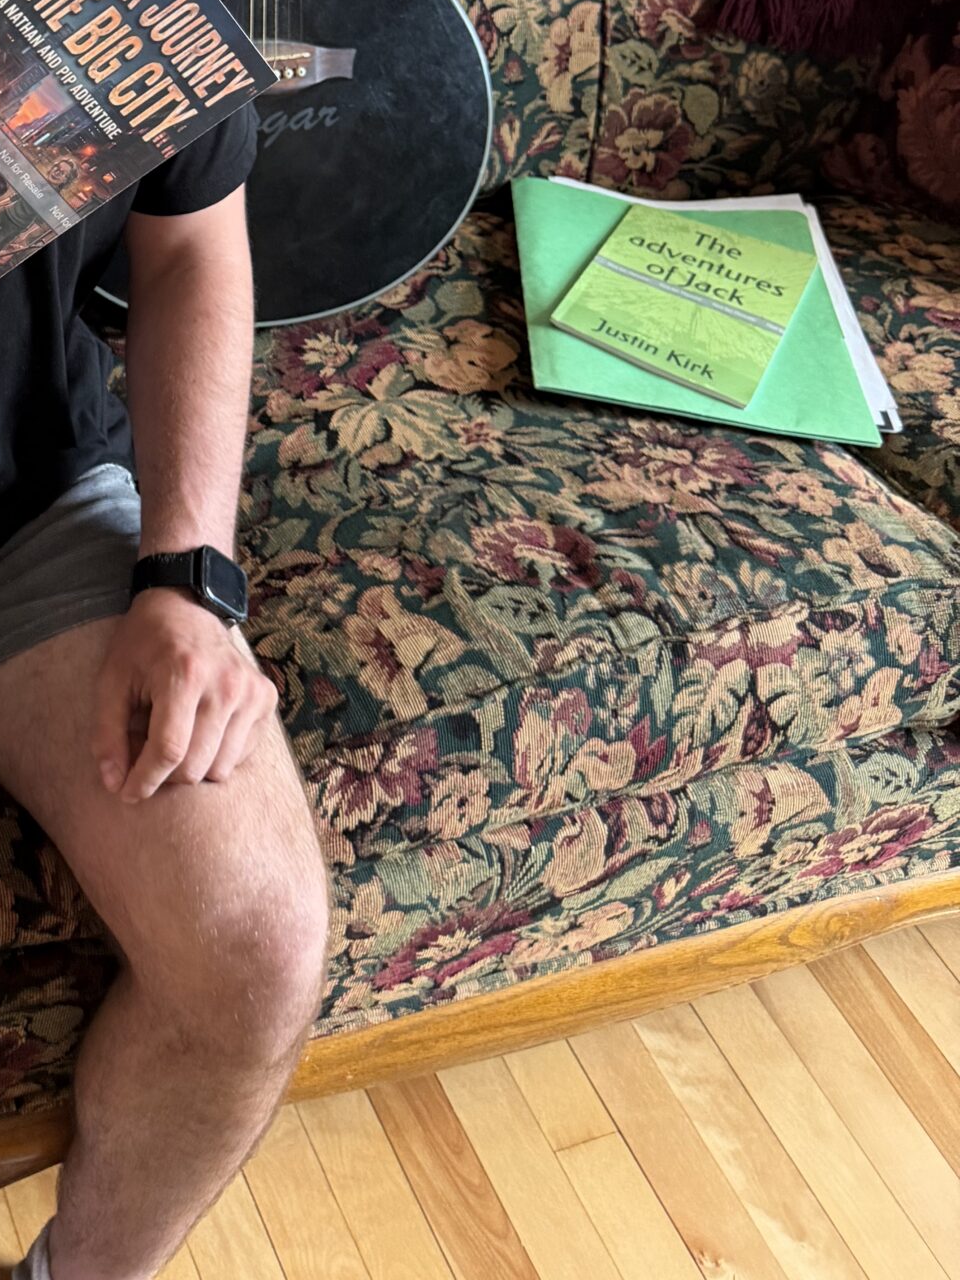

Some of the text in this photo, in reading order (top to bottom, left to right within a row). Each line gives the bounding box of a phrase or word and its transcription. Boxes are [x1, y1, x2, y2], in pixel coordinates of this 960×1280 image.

[4, 2, 48, 47] NATHAN
[37, 42, 63, 70] AND
[55, 65, 77, 87] PIP
[69, 79, 122, 140] ADVENTURE
[63, 5, 144, 84] BIG
[108, 62, 198, 142] CITY
[259, 104, 340, 149] gar
[10, 162, 24, 176] for
[19, 172, 45, 199] Resale
[49, 204, 64, 220] Not
[629, 235, 786, 297] adventures
[695, 231, 743, 260] The
[646, 263, 678, 283] of
[677, 270, 744, 306] Jack
[592, 317, 714, 380] Justin Kirk
